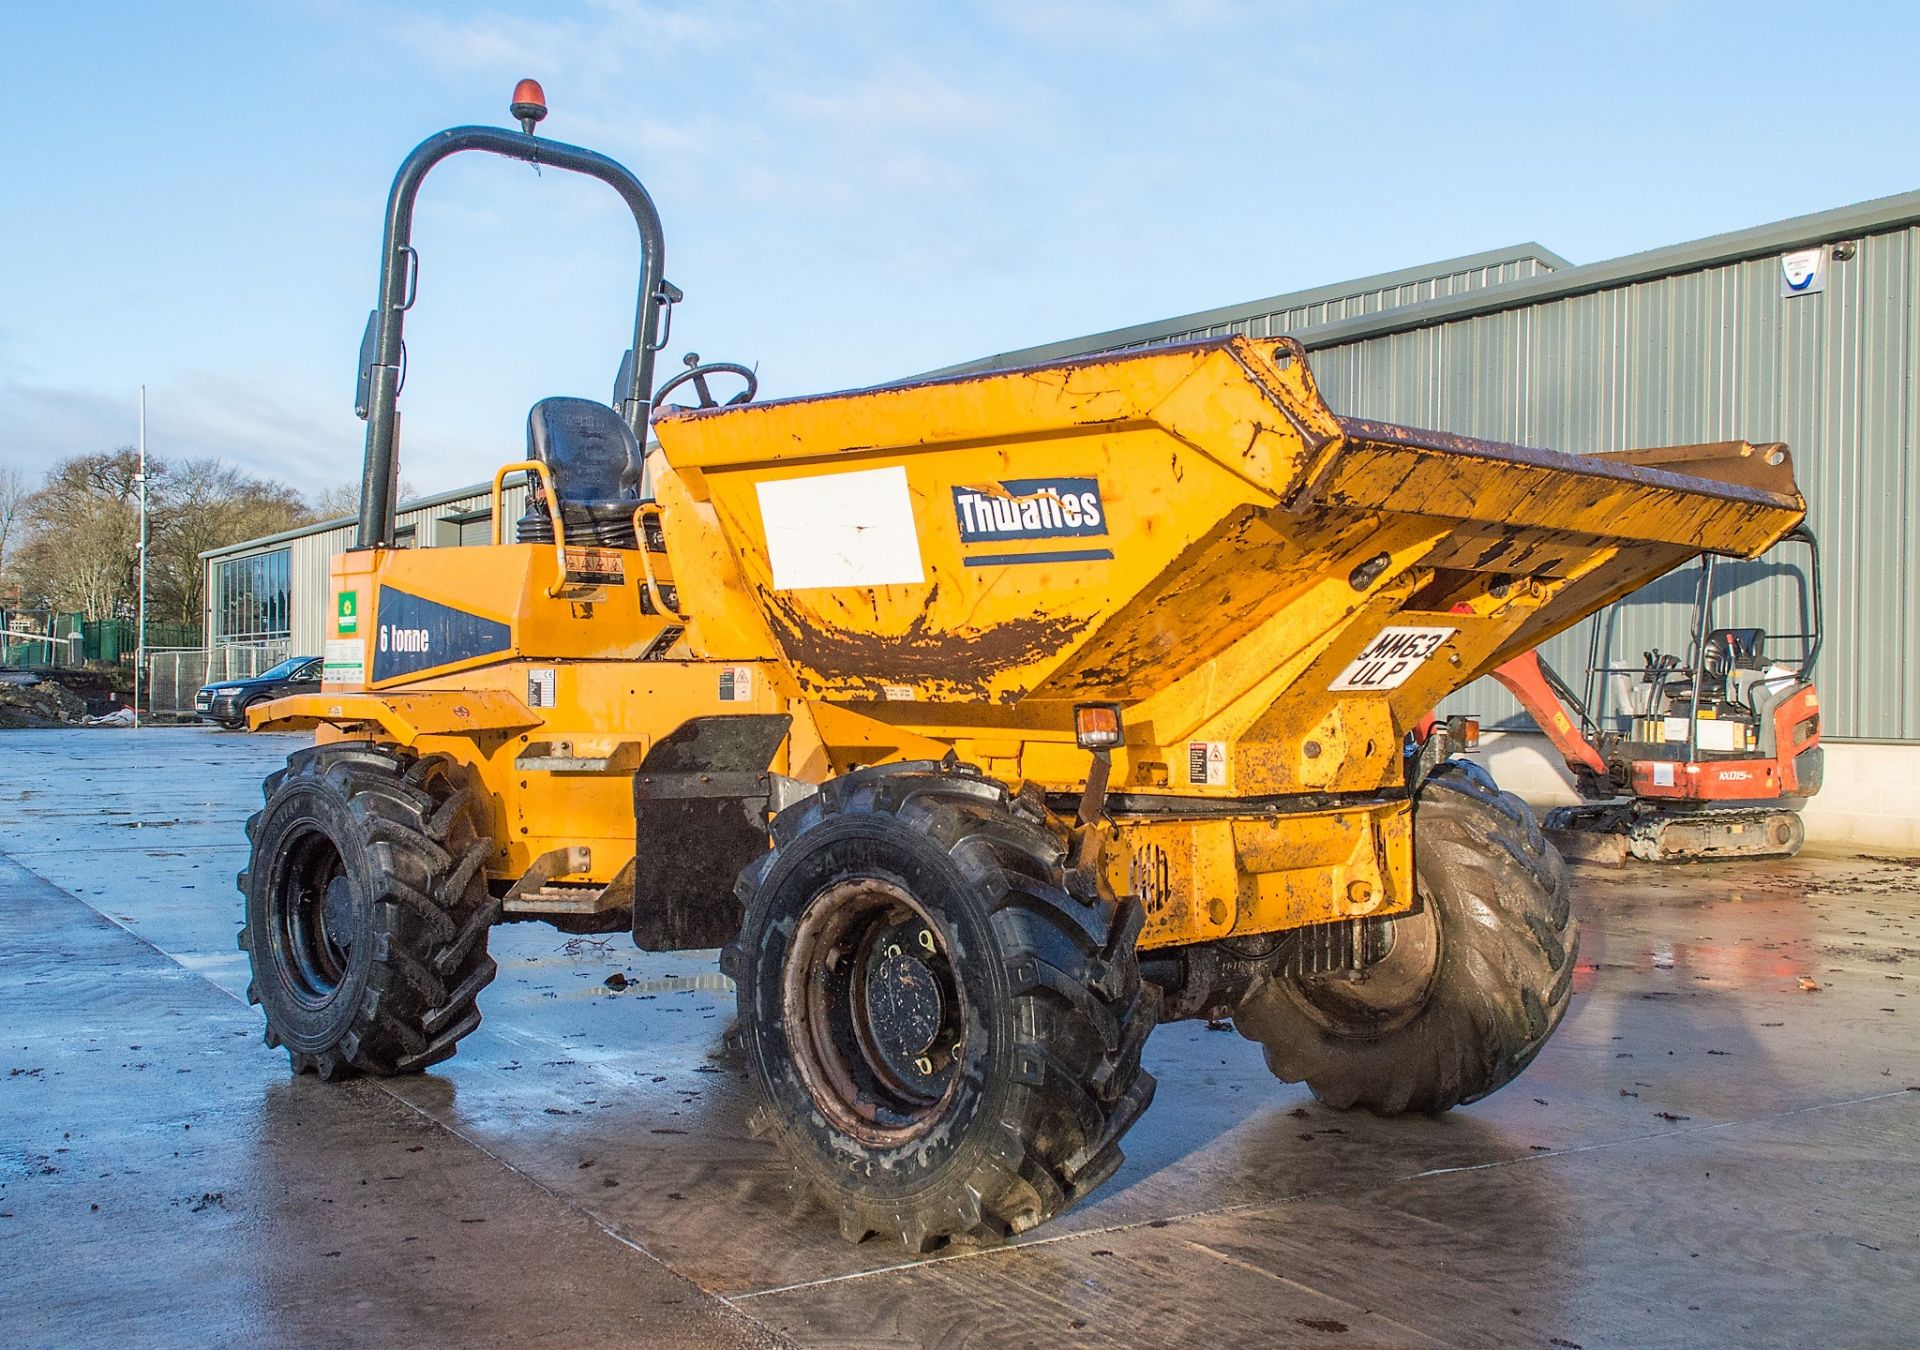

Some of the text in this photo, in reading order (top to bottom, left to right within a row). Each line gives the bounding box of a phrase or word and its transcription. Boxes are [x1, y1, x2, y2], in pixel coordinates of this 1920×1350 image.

[957, 487, 1101, 533] Thwaites
[380, 624, 388, 652] 6
[391, 624, 430, 653] tonne
[1366, 634, 1443, 659] MM63
[1348, 661, 1408, 685] ULP
